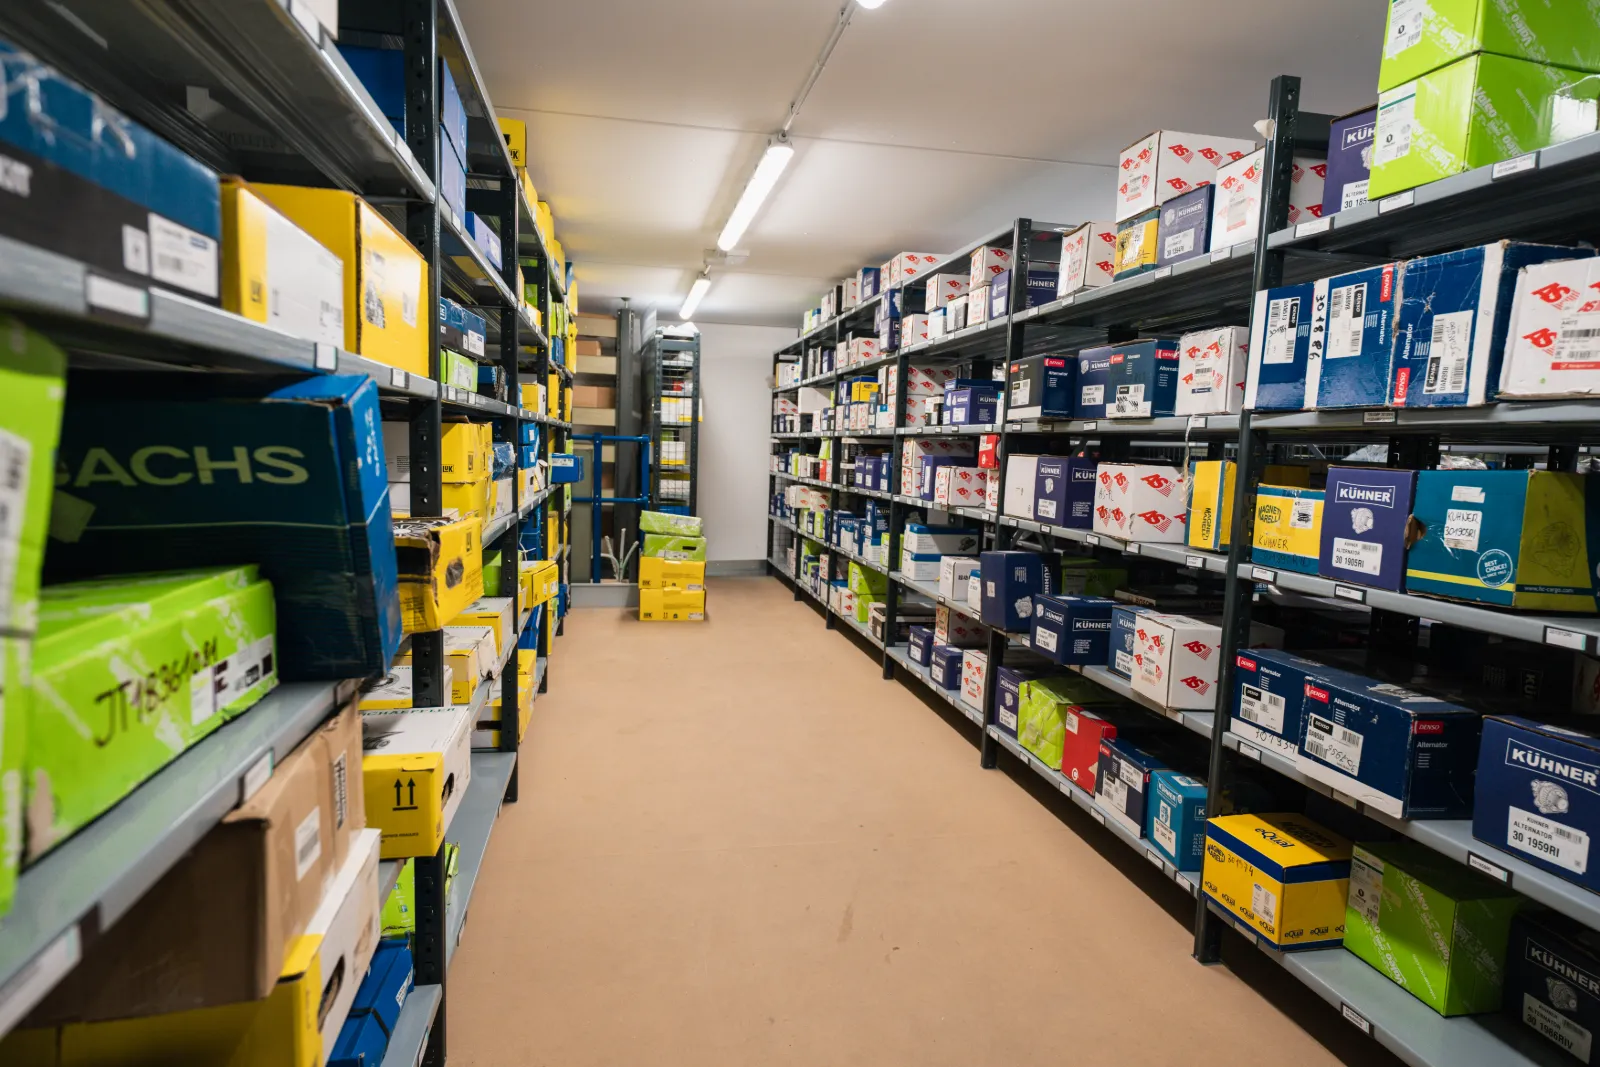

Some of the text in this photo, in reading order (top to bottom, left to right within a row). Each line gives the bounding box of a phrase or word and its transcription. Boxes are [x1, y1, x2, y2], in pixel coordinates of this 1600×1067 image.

[1344, 200, 1353, 209] 30
[1379, 309, 1387, 345] Alternator
[1403, 323, 1413, 360] Alternator
[1398, 371, 1406, 397] DENSO
[1339, 487, 1391, 503] KÜHNER
[1336, 548, 1360, 556] ALTERNATOR
[1335, 555, 1364, 568] 30 1905RI
[1484, 559, 1498, 568] BEST
[1075, 620, 1112, 629] KÜHNER
[1240, 659, 1255, 670] DENSO
[1260, 666, 1282, 678] Alternator
[1309, 689, 1327, 699] DENSO
[1334, 697, 1361, 711] Alternator
[1315, 720, 1330, 730] DENSO
[1418, 723, 1441, 731] DENSO
[1511, 747, 1598, 788] KÜHNER
[1198, 808, 1205, 816] K
[1526, 816, 1549, 830] KÜHNER
[1513, 820, 1553, 841] ALTERNATOR
[1512, 830, 1560, 858] 30 1959RI
[1221, 892, 1236, 907] eQual
[1239, 905, 1255, 921] eQual
[1258, 919, 1275, 936] eQual
[1284, 929, 1304, 939] eQual
[1309, 926, 1329, 936] eQual
[1530, 946, 1600, 995] KÜHNER
[1526, 1014, 1537, 1027] 30
[1527, 1005, 1561, 1030] ALTERNATOR
